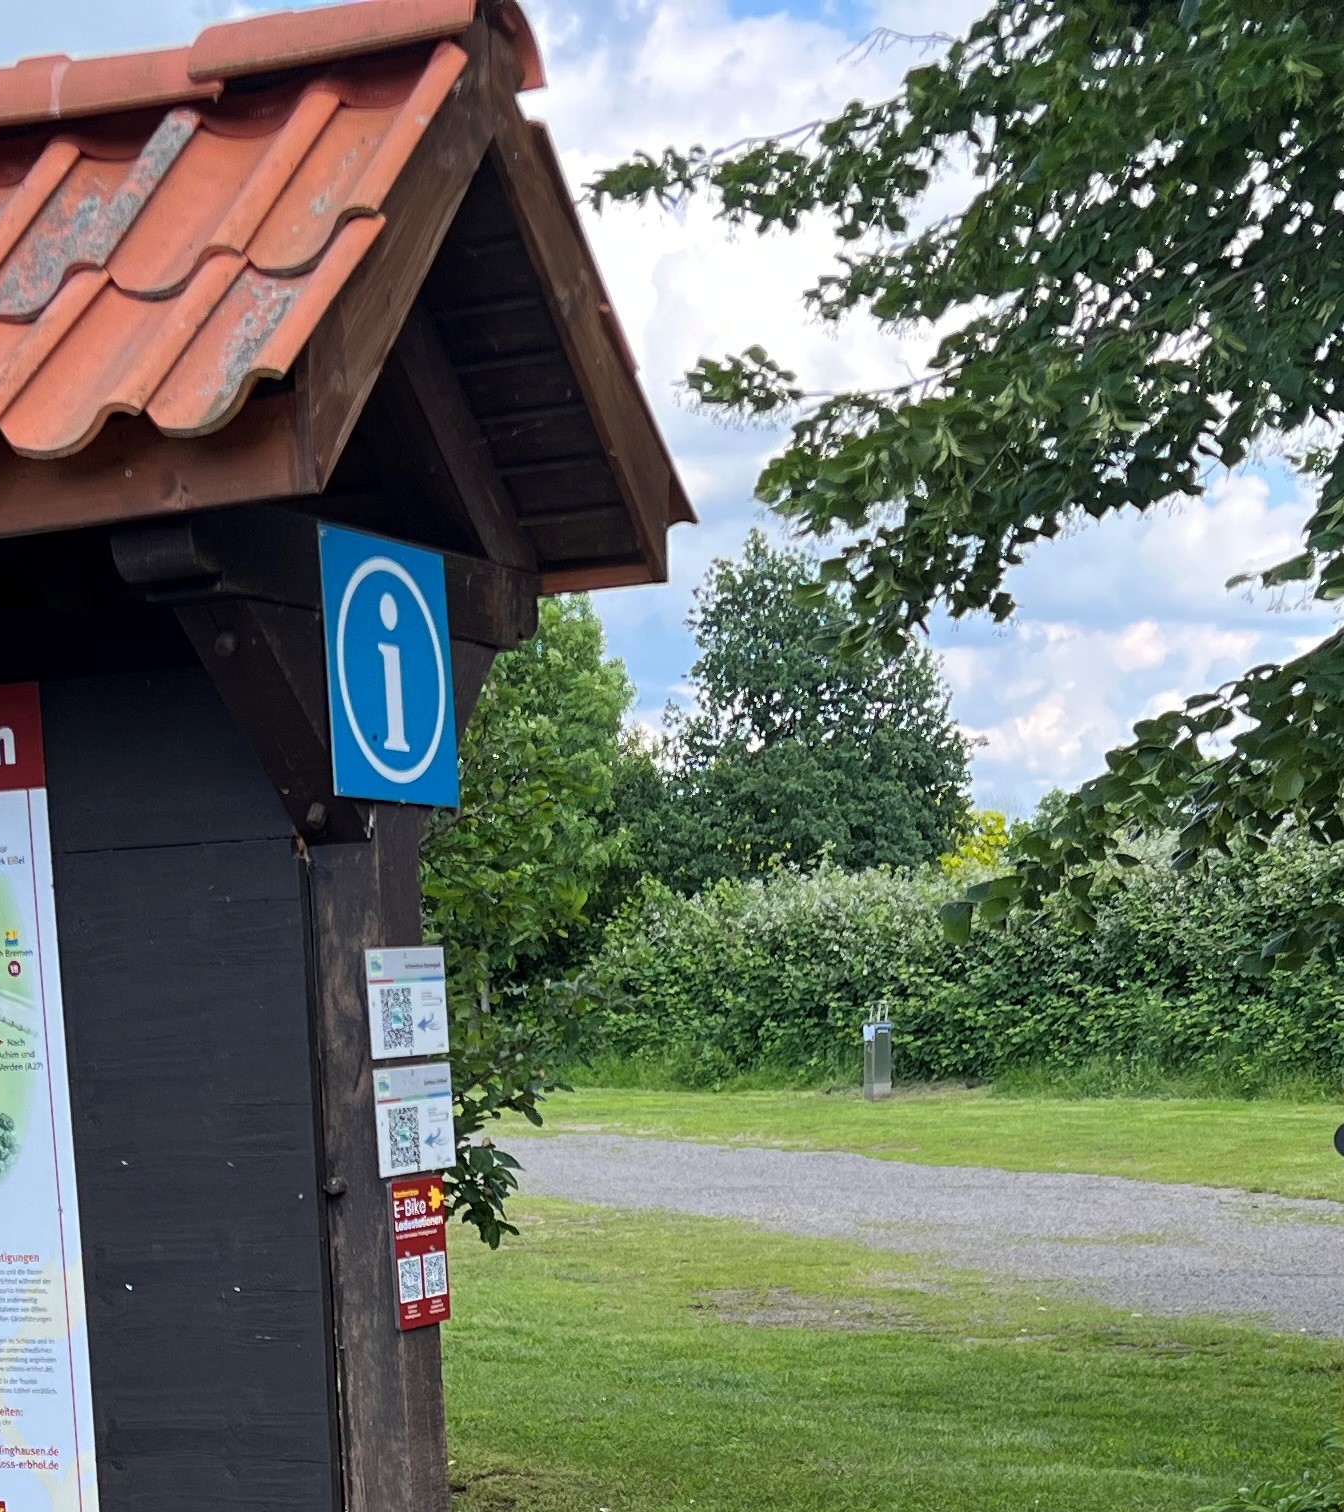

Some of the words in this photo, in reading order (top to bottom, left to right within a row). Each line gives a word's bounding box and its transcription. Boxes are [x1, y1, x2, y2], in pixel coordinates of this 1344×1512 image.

[5, 948, 32, 957] Bremen
[7, 1038, 25, 1046] Nach
[393, 1198, 427, 1219] E-Bike
